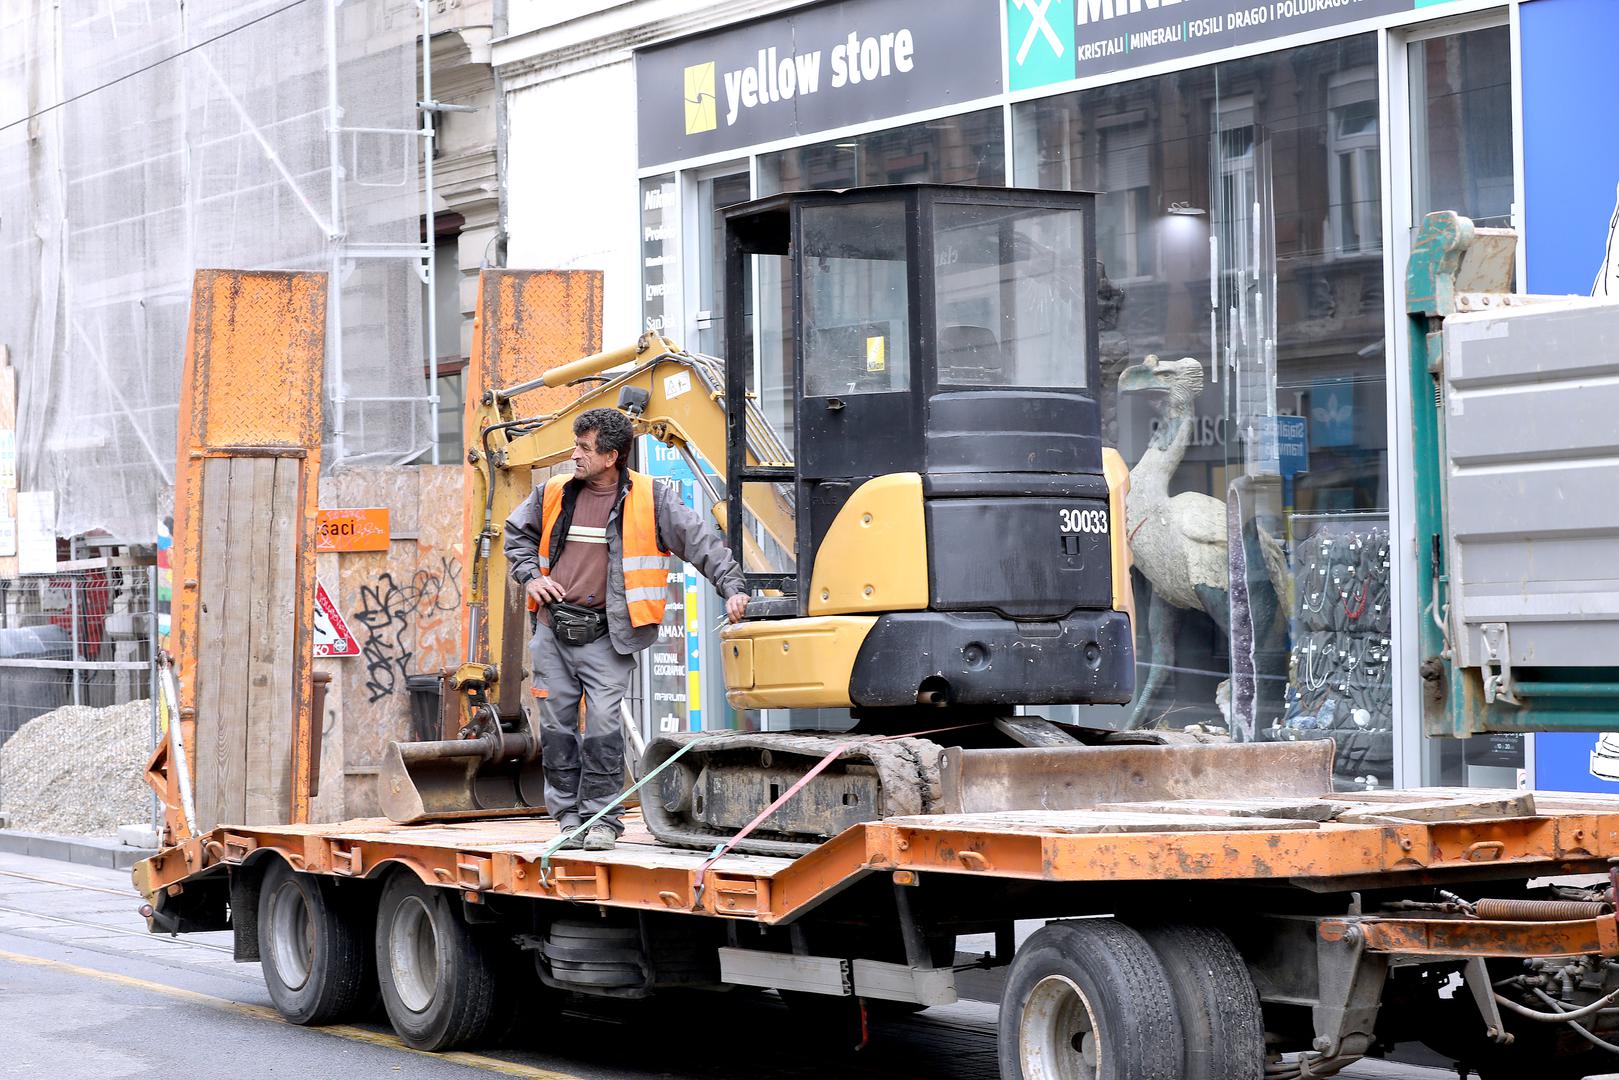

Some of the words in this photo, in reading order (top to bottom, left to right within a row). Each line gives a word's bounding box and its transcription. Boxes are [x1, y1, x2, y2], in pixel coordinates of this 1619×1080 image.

[1077, 36, 1124, 62] KRISTALI
[1130, 24, 1182, 50] MINERALI
[1188, 15, 1223, 39] FOSILI
[1227, 6, 1268, 31] DRAGO
[1270, 7, 1275, 21] I
[723, 46, 821, 127] yellow
[831, 28, 914, 88] store
[316, 519, 354, 536] šaci
[1059, 508, 1108, 534] 30033
[653, 652, 679, 665] NATIONAL
[653, 665, 686, 677] GEOGRAPHIC
